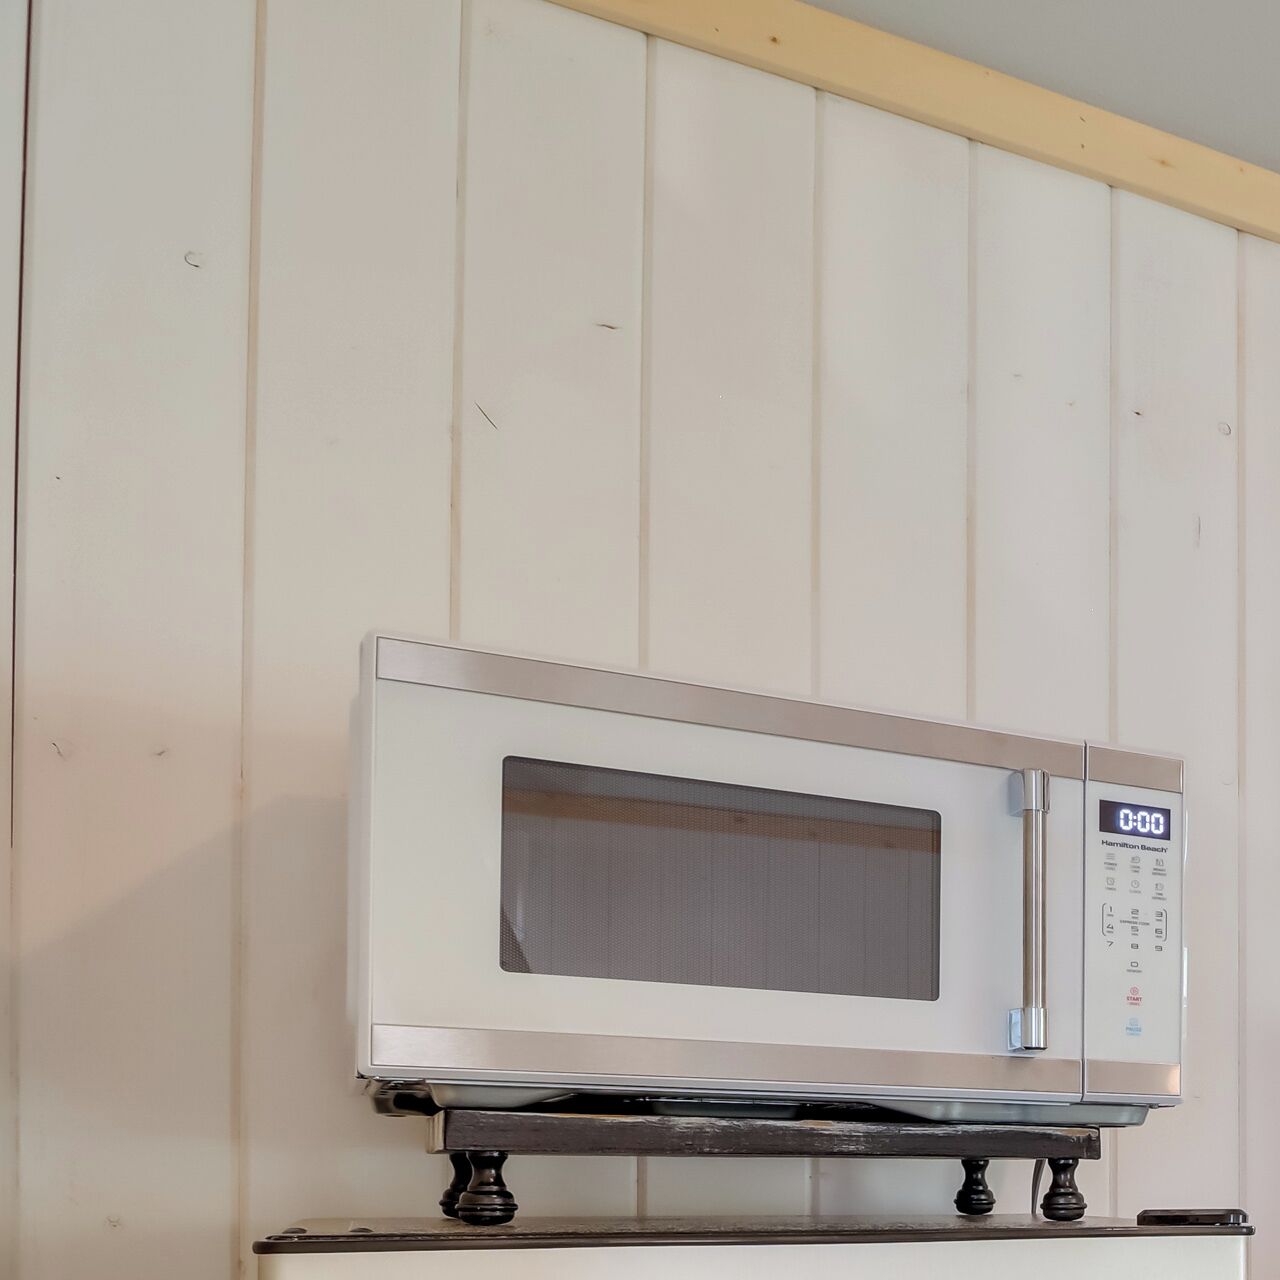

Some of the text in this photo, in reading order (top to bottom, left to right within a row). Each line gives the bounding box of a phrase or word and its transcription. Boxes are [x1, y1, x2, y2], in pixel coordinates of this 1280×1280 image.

[1120, 809, 1164, 835] 0:00
[1101, 839, 1167, 853] Hamilton Beach
